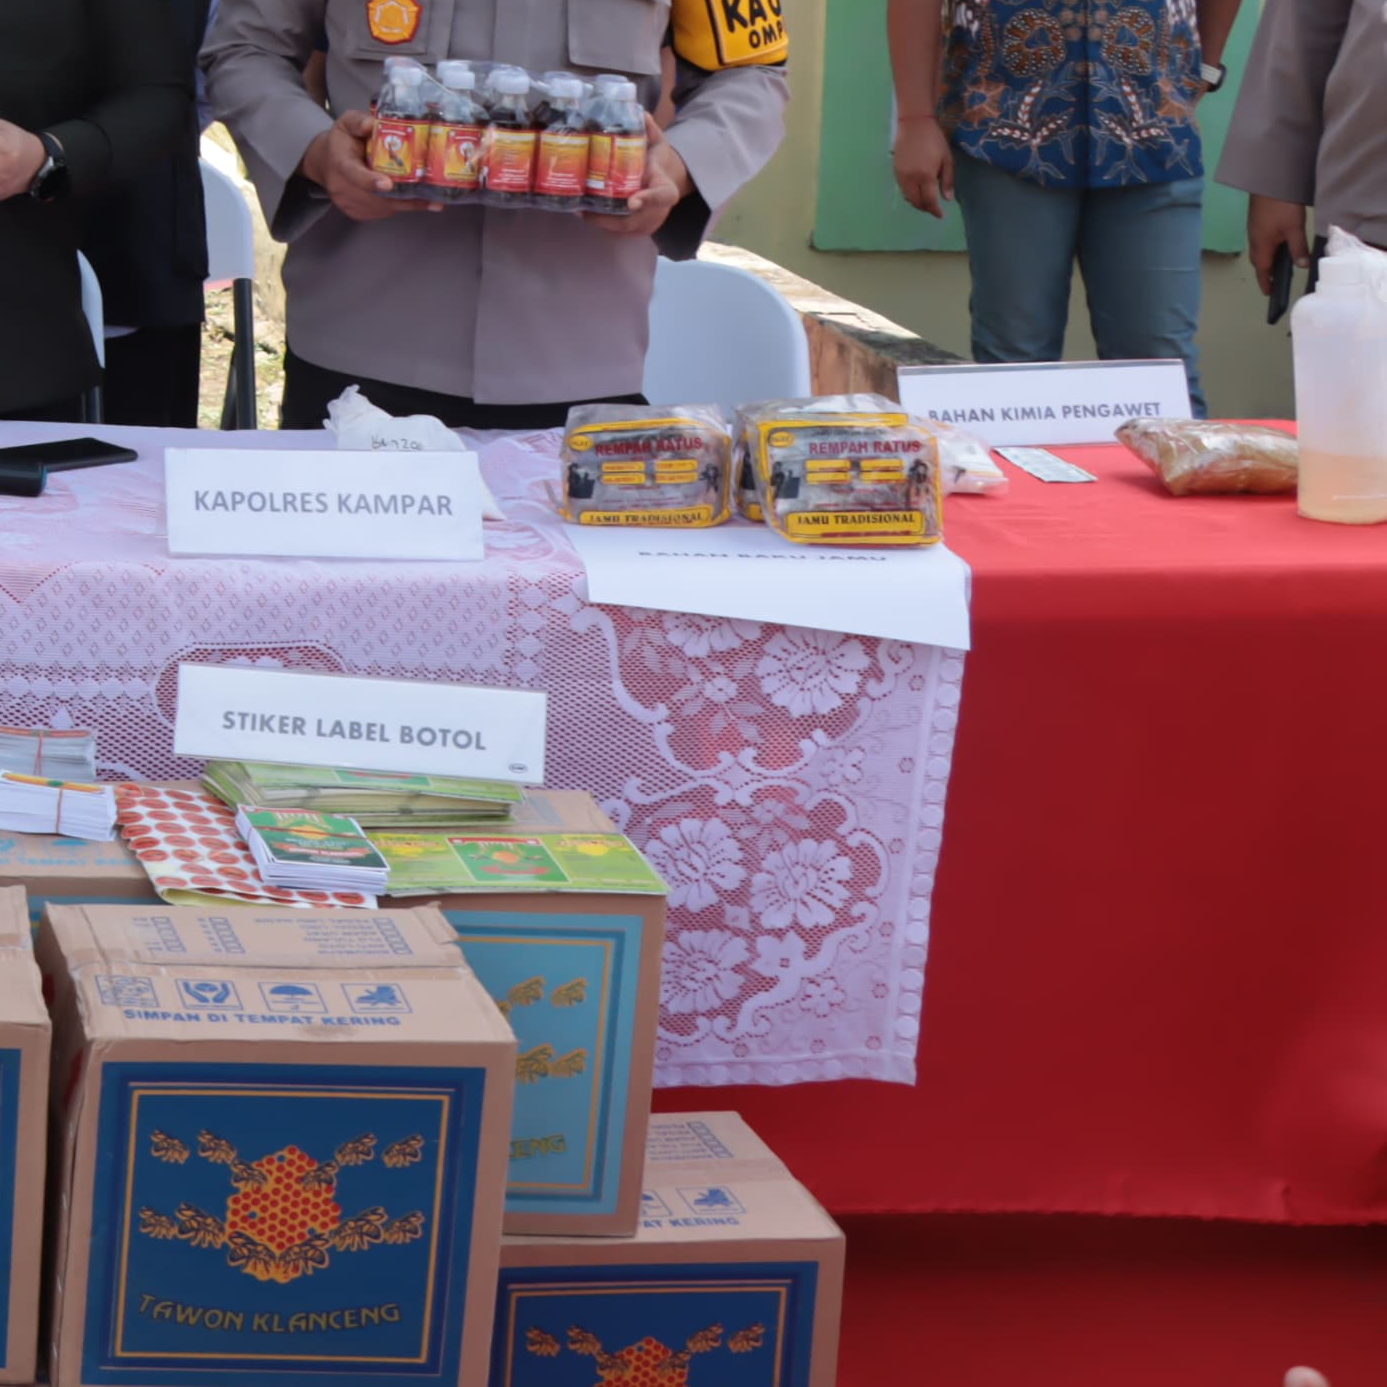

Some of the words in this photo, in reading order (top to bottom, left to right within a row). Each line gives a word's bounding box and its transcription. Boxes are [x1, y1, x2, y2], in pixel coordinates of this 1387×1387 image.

[929, 407, 996, 424] BAHAN
[1001, 405, 1055, 422] KIMIA
[1062, 402, 1162, 419] PENGAWET
[594, 440, 652, 457] REMPAH
[656, 437, 704, 453] RATUS
[809, 441, 867, 455] REMPAH
[873, 439, 922, 454] RATUS
[194, 489, 329, 515] KAPOLRES
[337, 490, 454, 517] KAMPAR
[589, 513, 620, 524] JAMU
[624, 510, 705, 525] TRADISIONAL
[797, 515, 829, 525] JAMU
[833, 512, 916, 525] TRADISIONAL
[223, 711, 307, 736] STIKER
[317, 718, 388, 743] LABEL
[397, 725, 486, 751] BOTOL
[124, 1009, 201, 1023] SIMPAN
[207, 1013, 228, 1023] DI
[235, 1014, 313, 1026] TEMPAT
[322, 1017, 401, 1026] KERING
[668, 1217, 740, 1227] KERING
[139, 1291, 244, 1333] TAWON
[252, 1300, 402, 1333] KLANCENG
